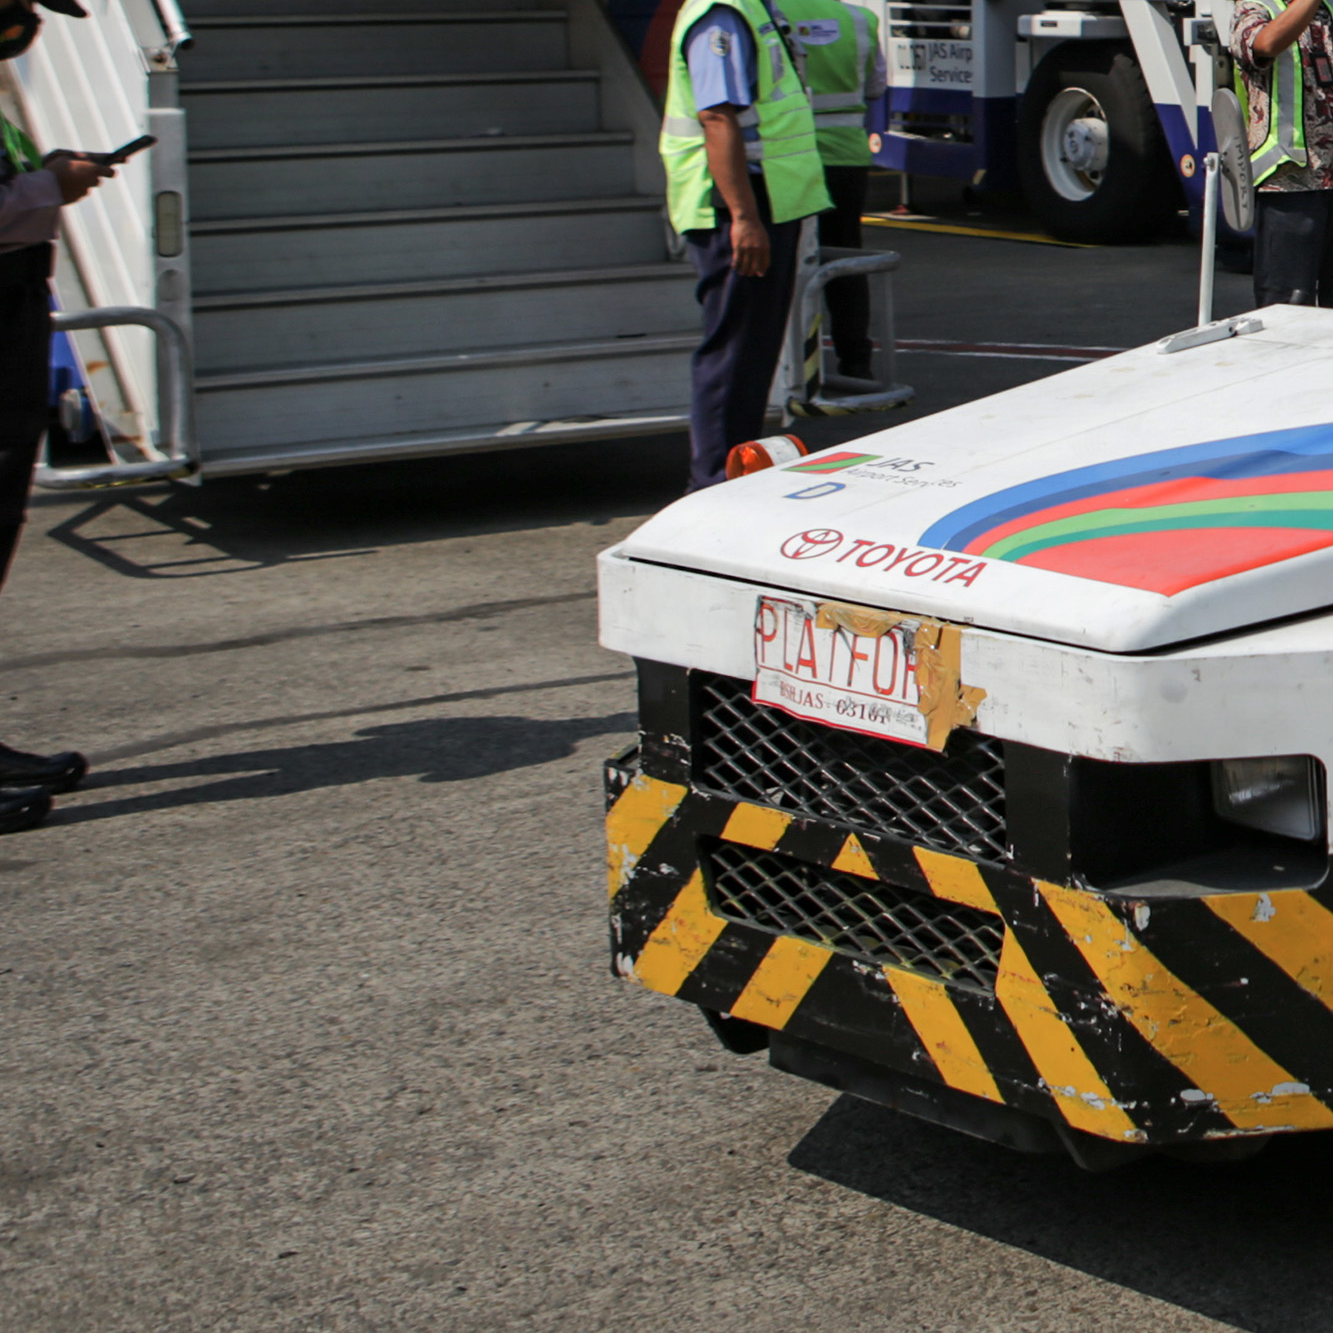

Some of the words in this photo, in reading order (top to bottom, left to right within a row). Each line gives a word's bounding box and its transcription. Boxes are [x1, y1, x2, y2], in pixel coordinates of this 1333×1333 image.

[929, 43, 947, 62] JAS
[950, 43, 973, 63] Airp
[865, 457, 936, 473] JAS
[836, 539, 988, 588] TOYOTA
